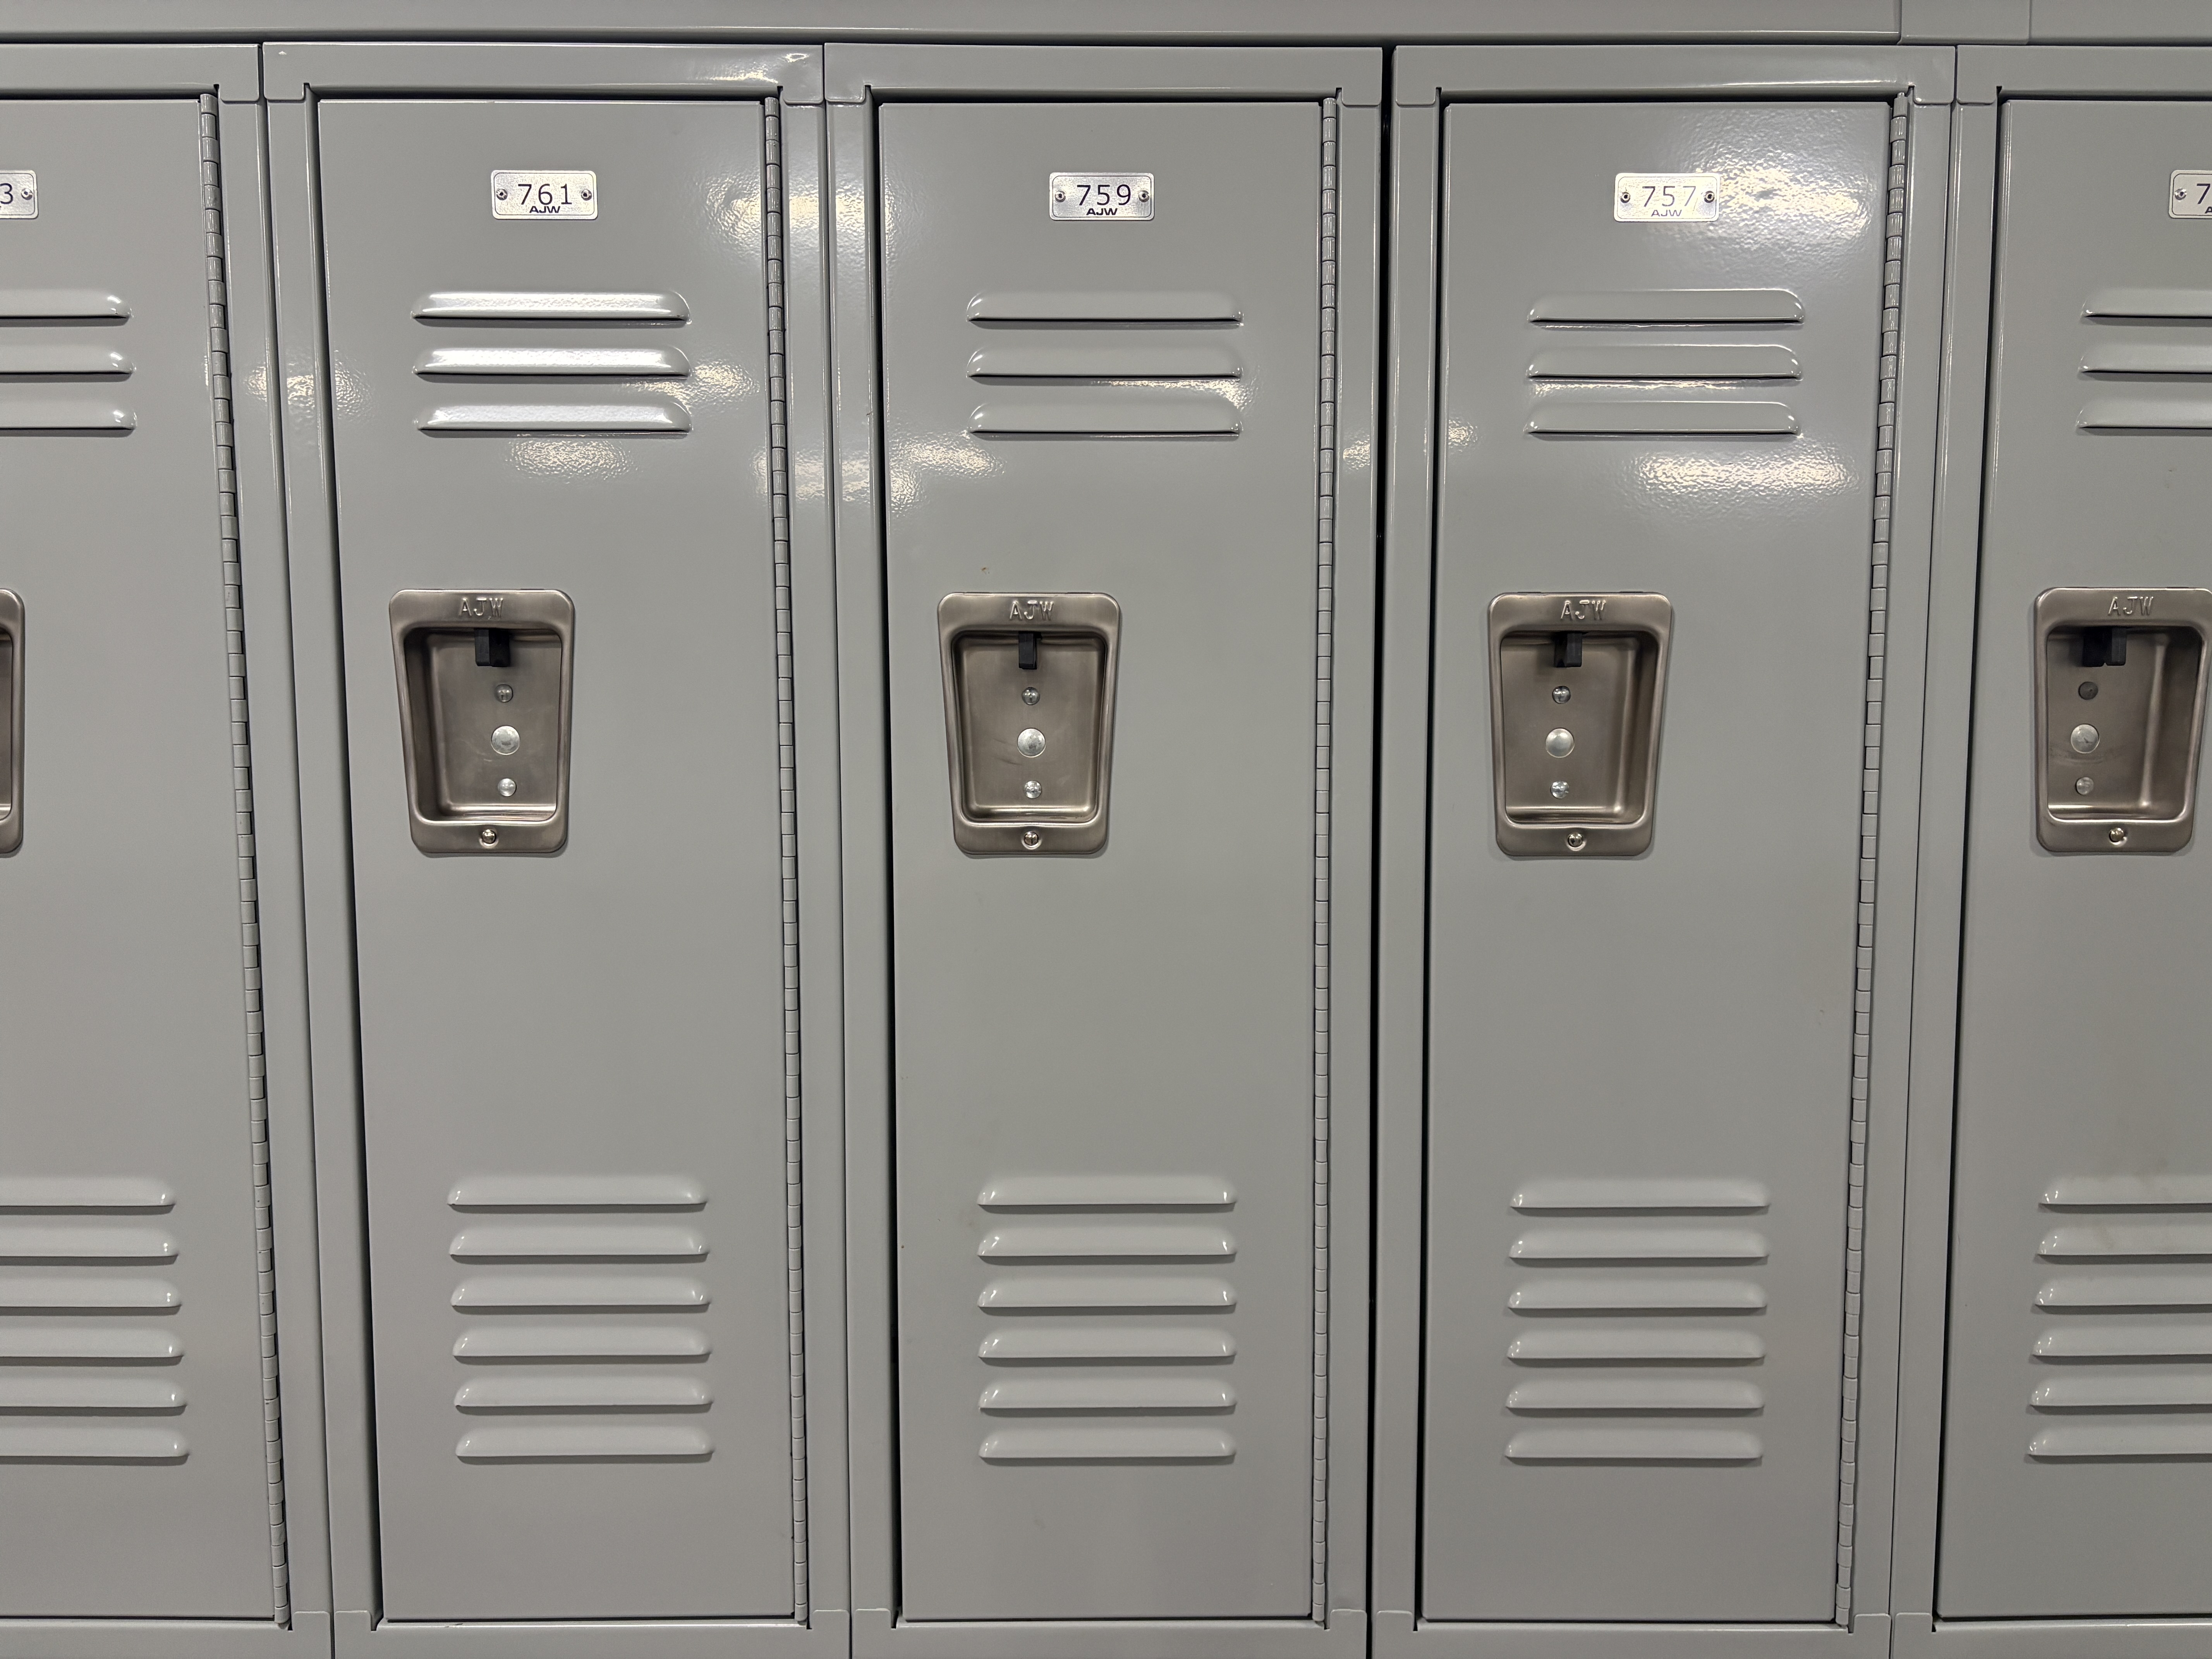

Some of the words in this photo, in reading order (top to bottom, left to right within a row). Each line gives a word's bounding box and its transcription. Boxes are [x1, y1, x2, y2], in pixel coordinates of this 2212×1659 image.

[518, 184, 572, 205] 761
[1077, 184, 1131, 206] 759
[1642, 185, 1696, 207] 757
[458, 597, 503, 617] AJW
[1009, 600, 1054, 620] AJW
[1560, 600, 1606, 620] AJW
[2107, 596, 2154, 616] AJW
